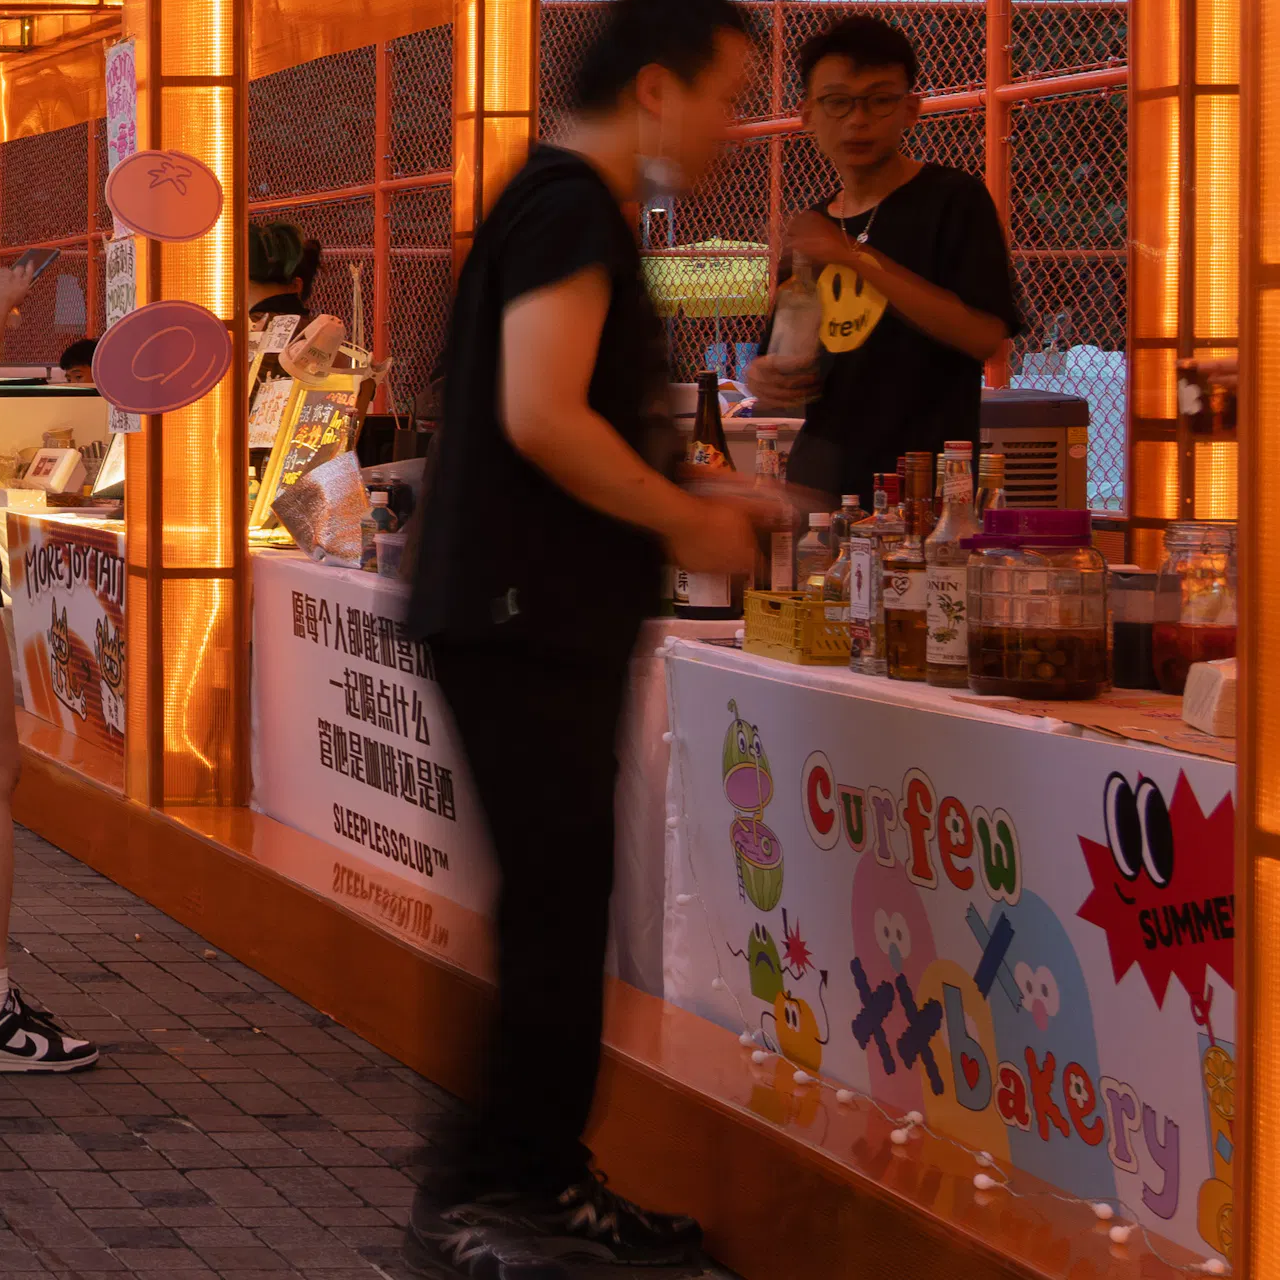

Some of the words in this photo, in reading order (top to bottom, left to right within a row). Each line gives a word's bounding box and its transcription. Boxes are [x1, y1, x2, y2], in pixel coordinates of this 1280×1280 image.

[24, 545, 65, 600] MORE
[329, 666, 431, 746] 一起喝点什么
[317, 717, 458, 822] 管他是咖啡还是酒
[1139, 894, 1237, 952] SUMME
